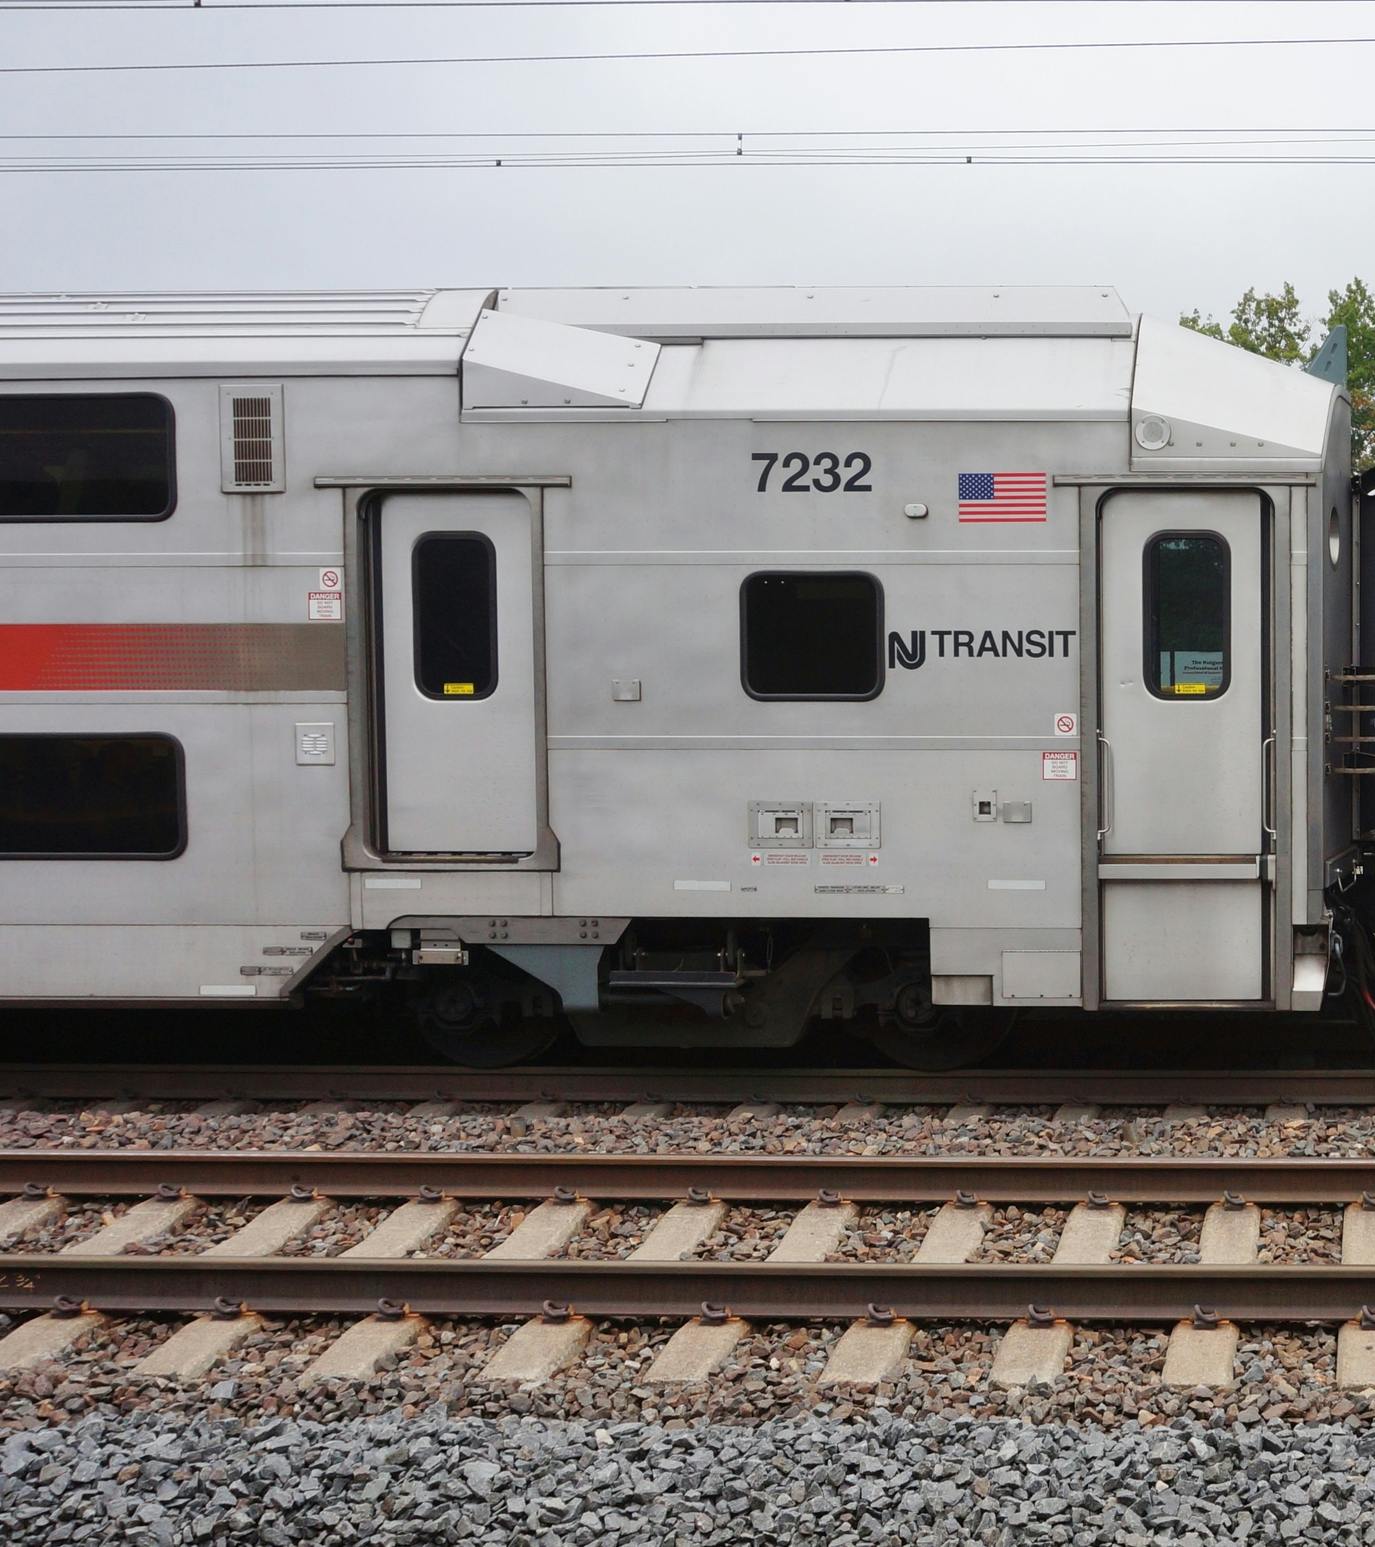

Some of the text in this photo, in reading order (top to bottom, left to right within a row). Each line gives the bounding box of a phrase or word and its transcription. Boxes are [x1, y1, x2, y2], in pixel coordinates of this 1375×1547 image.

[751, 452, 872, 492] 7232
[888, 630, 1076, 670] NJ TRANSIT
